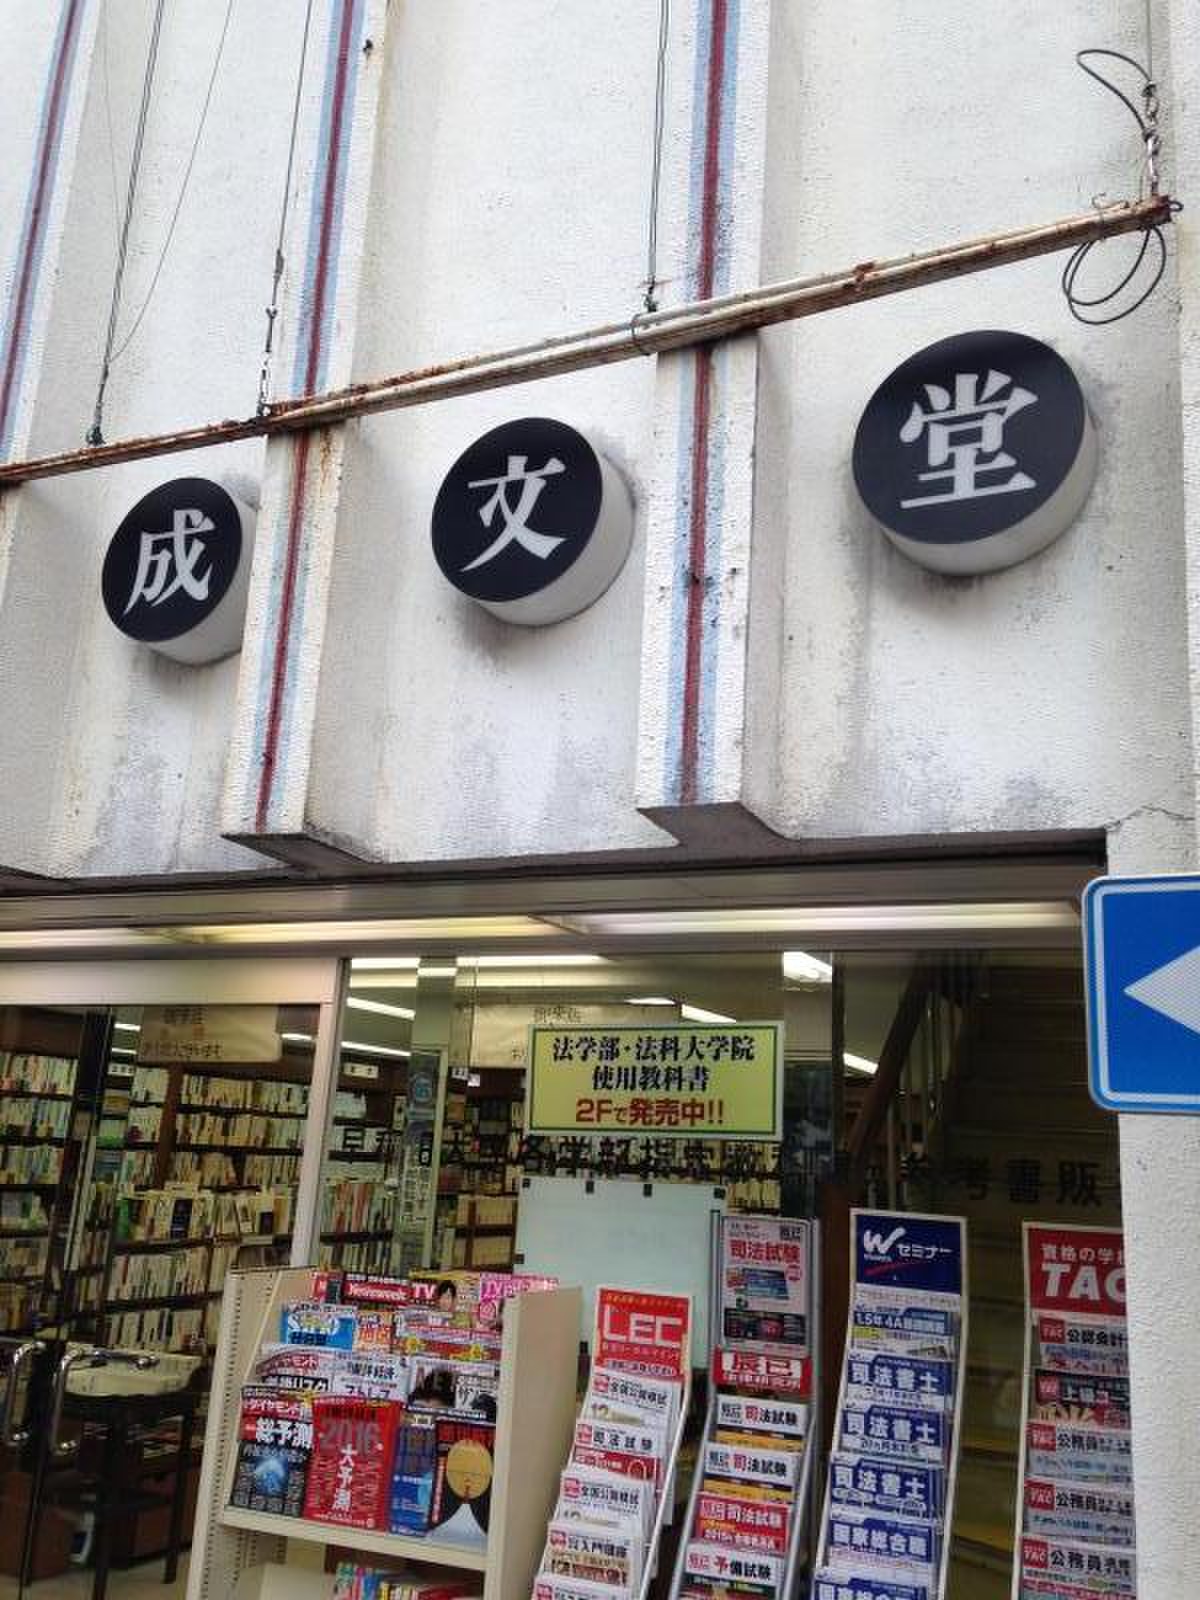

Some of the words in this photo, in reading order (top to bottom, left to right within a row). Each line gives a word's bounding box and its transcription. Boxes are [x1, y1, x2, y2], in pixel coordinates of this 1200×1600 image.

[124, 509, 214, 615] 成
[461, 456, 566, 572] 文
[900, 370, 1039, 509] 堂
[552, 1035, 756, 1062] 法学部・法科大学院
[592, 1065, 710, 1092] 使用教科書
[897, 1244, 952, 1260] セミナー
[1040, 1243, 1124, 1265] 資格の学
[1041, 1263, 1126, 1304] TAC
[603, 1303, 682, 1348] LEC
[850, 1361, 939, 1393] 司法書士
[745, 1405, 798, 1426] 司法試験
[847, 1412, 936, 1444] 司法書士
[733, 1453, 787, 1477] 司法試験
[835, 1466, 926, 1500] 司法書士
[714, 1555, 771, 1580] 予備試験
